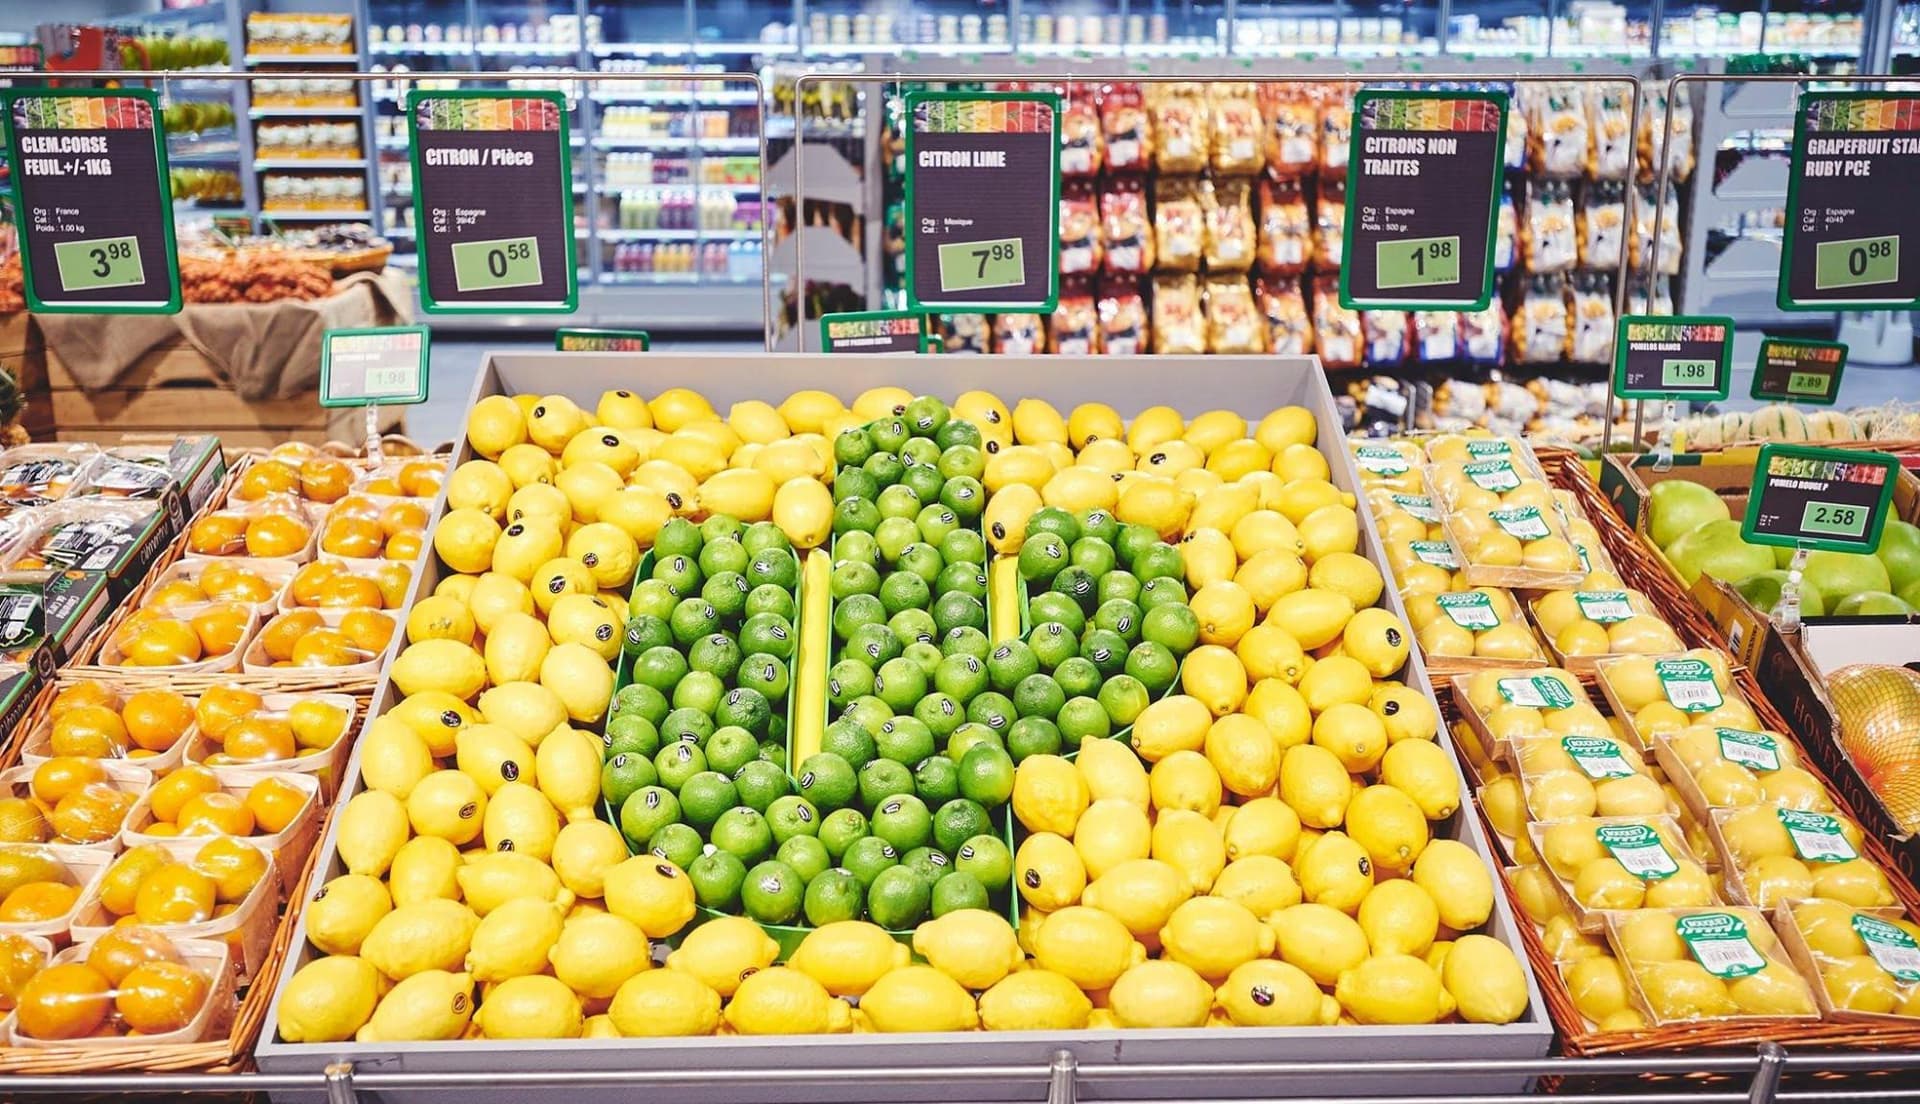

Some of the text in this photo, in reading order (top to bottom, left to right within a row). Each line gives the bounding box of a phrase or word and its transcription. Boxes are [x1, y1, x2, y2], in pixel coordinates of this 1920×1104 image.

[21, 136, 108, 154] CLEM.CORSE
[1365, 137, 1457, 155] CITRONS NON
[1807, 138, 1890, 156] GRAPEFRUIT
[425, 148, 534, 166] CITRON / Pièce
[918, 151, 1006, 167] CITRON LIME
[24, 158, 112, 176] FEUIL.+/-1KG
[1364, 159, 1420, 176] TRAITES
[1805, 160, 1871, 177] RUBY PCE
[33, 207, 47, 216] Org
[55, 207, 79, 215] France
[455, 208, 486, 217] Espagne
[1363, 207, 1376, 216] Org
[1385, 207, 1415, 216] Espagne
[1804, 208, 1817, 216] Org
[1825, 208, 1855, 217] Espagne
[35, 224, 55, 232] Poids
[60, 224, 75, 232] 1.00
[75, 224, 85, 234] kg
[1361, 223, 1382, 231] Poids
[1386, 223, 1399, 232] 500
[1630, 343, 1657, 351] POMELOS
[1673, 364, 1705, 378] 1.98
[1769, 478, 1829, 491] POMELO ROUGE P
[1814, 507, 1855, 526] 2.58
[1792, 694, 1841, 777] HONEY
